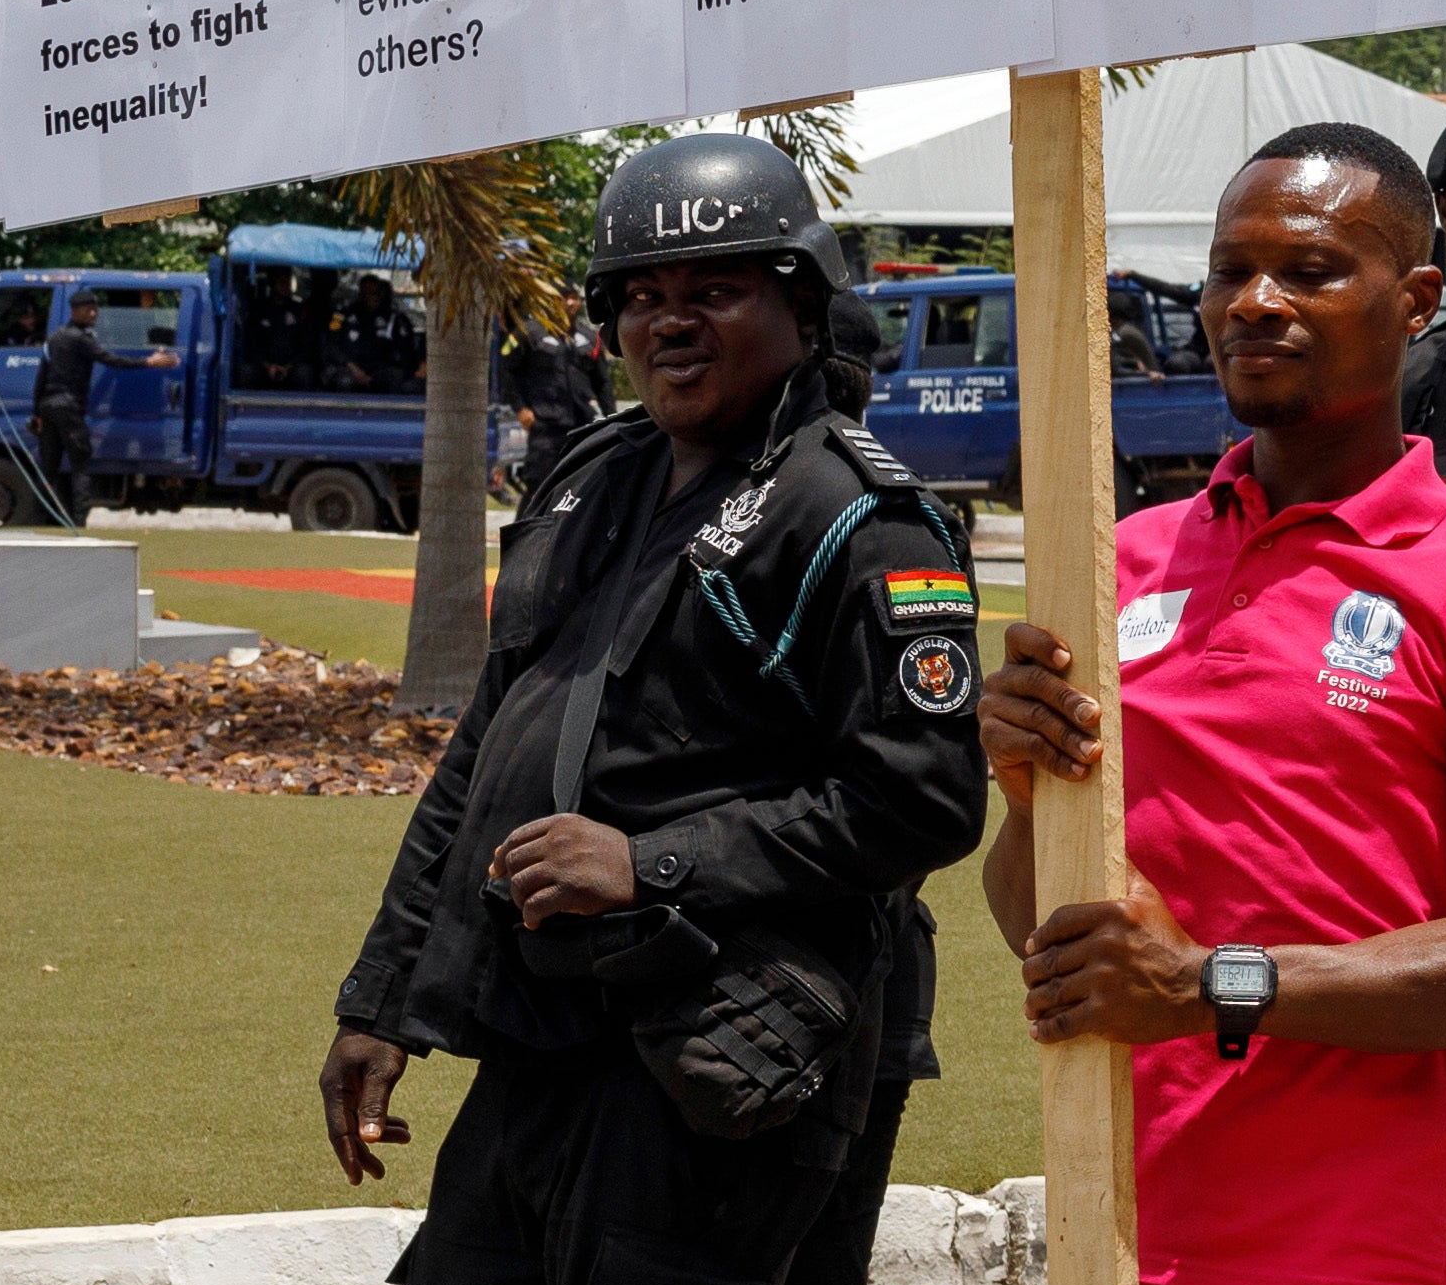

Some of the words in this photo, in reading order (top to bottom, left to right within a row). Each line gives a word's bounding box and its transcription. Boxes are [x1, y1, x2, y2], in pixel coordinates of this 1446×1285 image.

[40, 30, 139, 72] forces
[148, 18, 181, 51] to
[357, 19, 484, 78] others?
[44, 74, 207, 137] inequality!
[918, 387, 984, 414] POLICE
[695, 522, 744, 557] POLICE
[907, 638, 951, 662] JUNGLER
[1317, 669, 1388, 700] Festival
[1326, 691, 1370, 714] 2022
